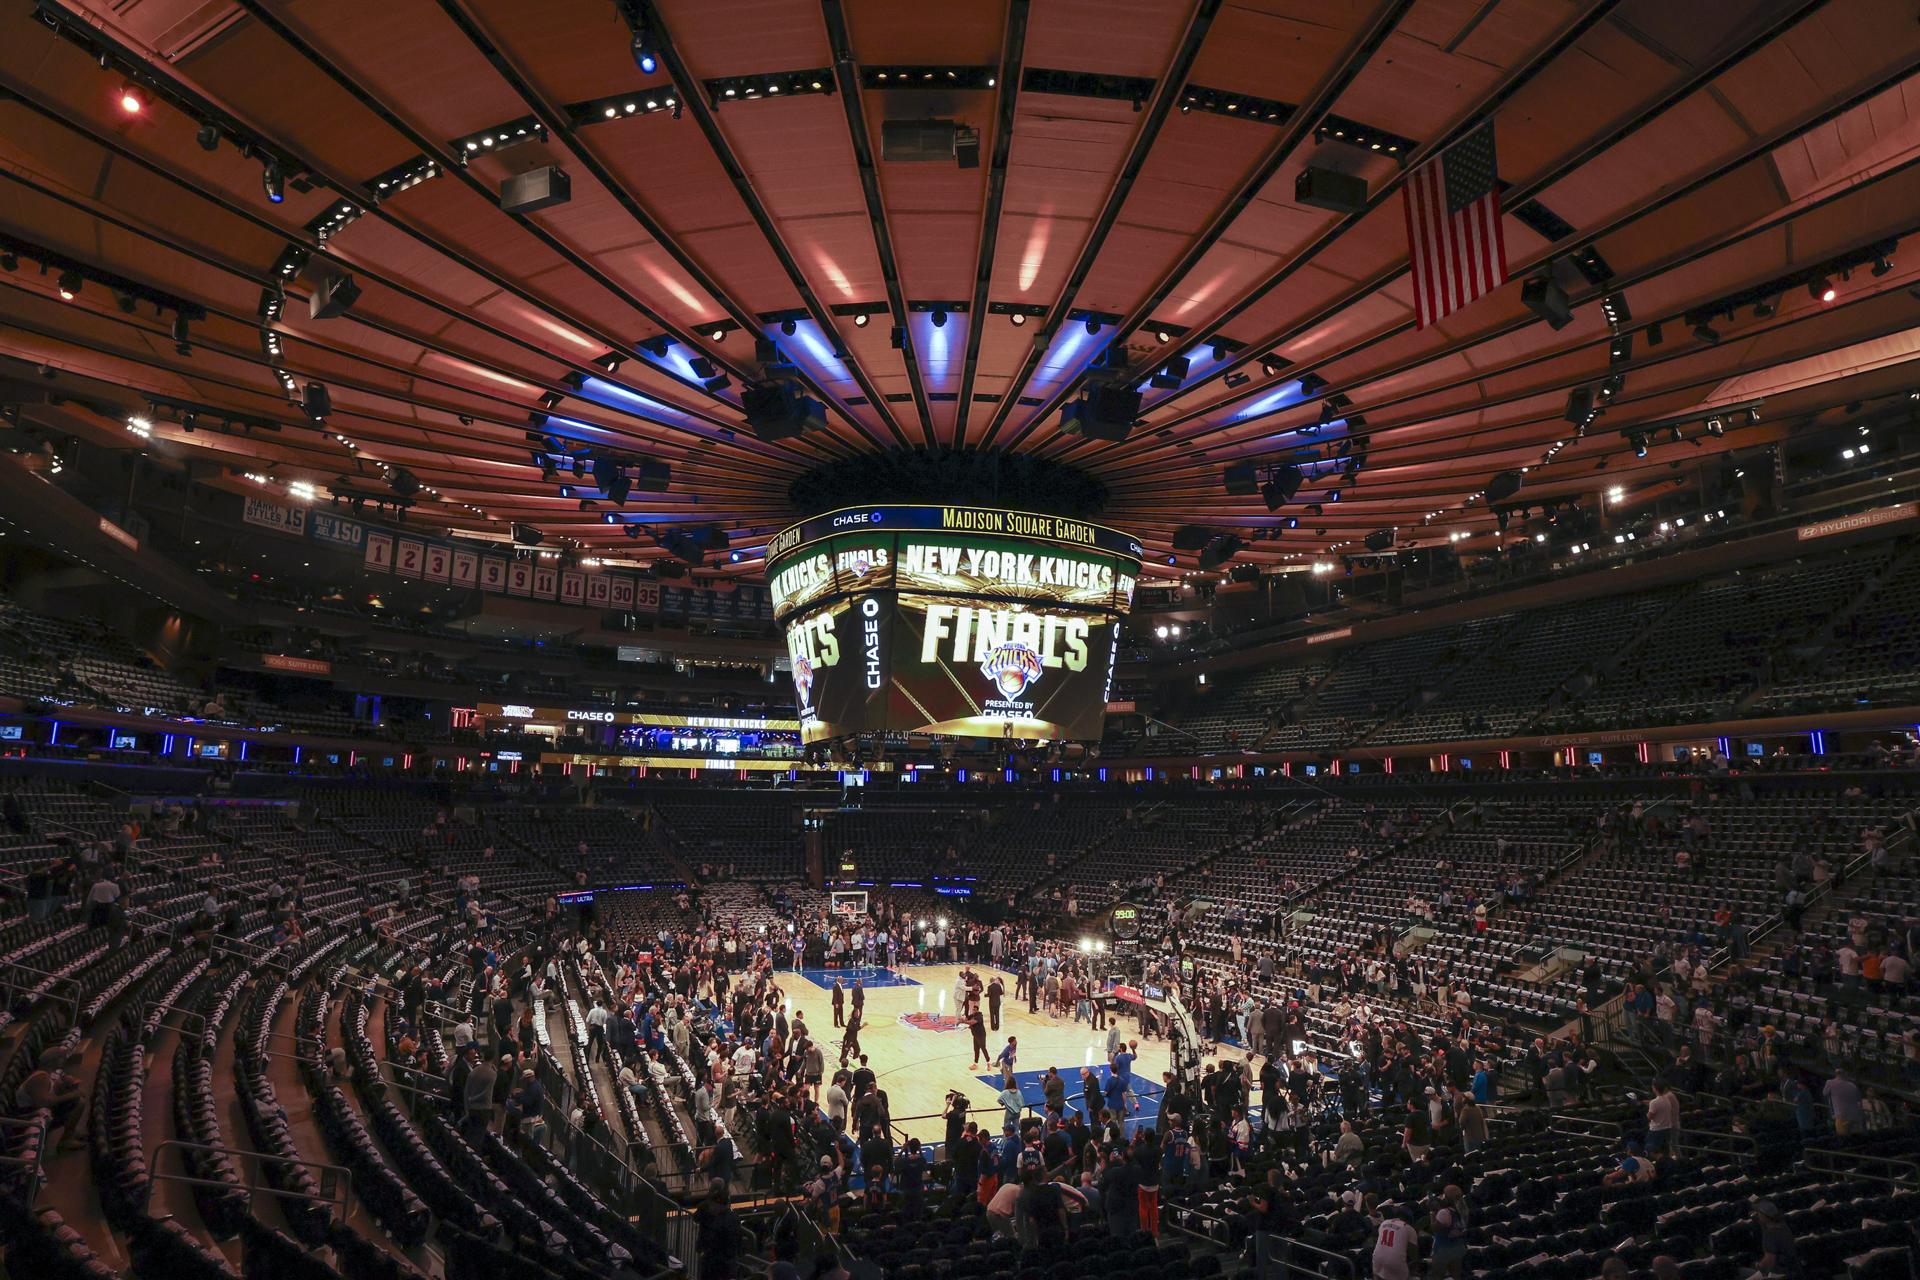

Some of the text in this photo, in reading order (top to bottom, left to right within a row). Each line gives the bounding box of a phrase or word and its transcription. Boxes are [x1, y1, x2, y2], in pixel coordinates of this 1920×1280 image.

[247, 507, 281, 522] STYLES
[285, 509, 302, 527] 15
[315, 515, 331, 527] BILLY
[833, 513, 869, 527] CHASE
[1820, 506, 1916, 533] HYUNDAI BRIDGE
[315, 526, 329, 536] JOEL
[333, 521, 361, 544] 150
[943, 508, 1096, 544] MADISON SQUARE GARDEN
[375, 545, 382, 562] 1
[404, 551, 415, 569] 2
[838, 548, 888, 571] FINALS
[433, 557, 443, 574] 3
[460, 562, 470, 578] 7
[906, 545, 1112, 591] NEW YORK KNICKS
[488, 567, 499, 583] 9
[516, 571, 525, 587] 9
[781, 553, 830, 597] KNICKS
[538, 575, 552, 592] 11
[566, 580, 580, 596] 11
[591, 583, 607, 599] 19
[613, 588, 631, 602] 30
[639, 589, 658, 604] 35
[1167, 590, 1182, 603] 13
[920, 604, 1089, 672] FINALS
[864, 619, 881, 688] CHASE
[990, 647, 1038, 669] KNICKS
[308, 662, 328, 672] LEVEL
[1103, 642, 1118, 704] CHASE
[985, 700, 1034, 710] PRESENTED BY
[568, 710, 604, 721] CHASE
[983, 709, 1023, 719] CHASE
[688, 717, 767, 729] NEW YORK KNICKS
[1601, 735, 1621, 743] SUITE
[705, 759, 736, 770] FINALS
[1381, 1230, 1395, 1247] 11
